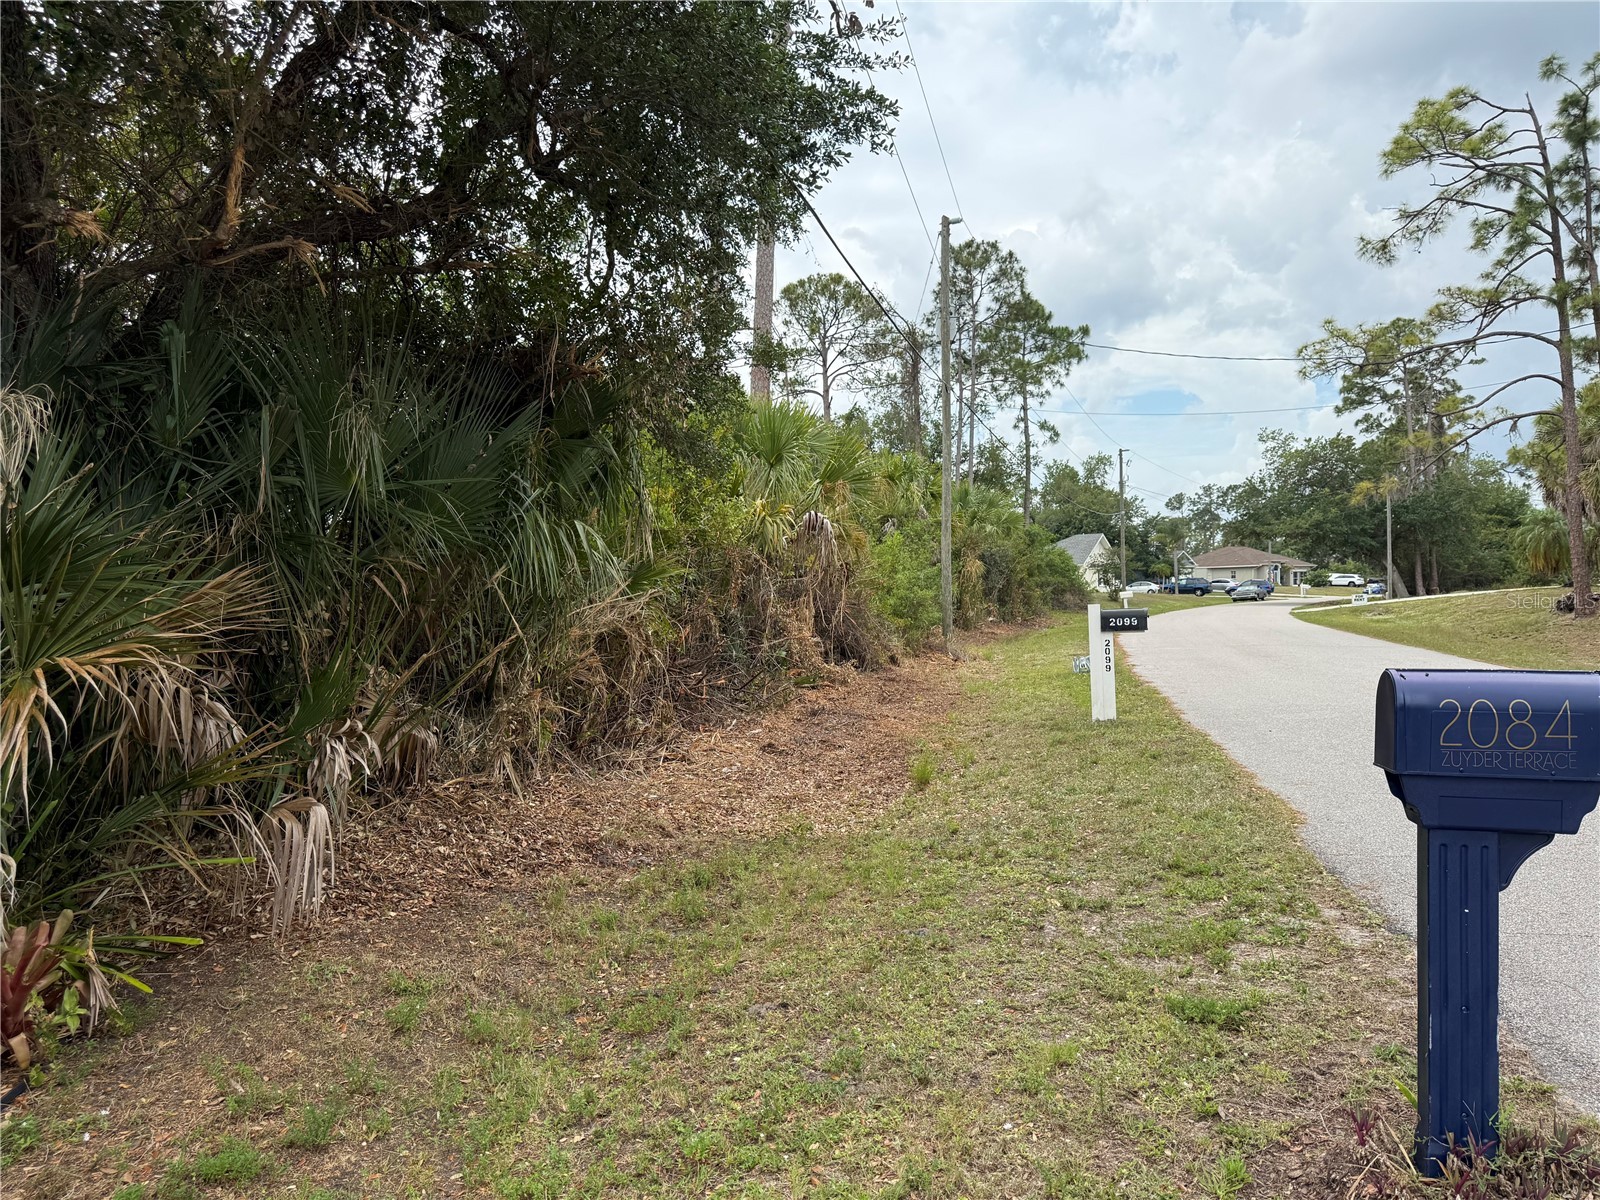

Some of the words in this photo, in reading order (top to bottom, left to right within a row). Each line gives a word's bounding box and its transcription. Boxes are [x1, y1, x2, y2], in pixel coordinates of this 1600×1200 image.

[1109, 618, 1138, 626] 2099
[1439, 699, 1578, 750] 2084
[1441, 751, 1508, 770] ZUYDER
[1507, 752, 1577, 771] TERRACE
